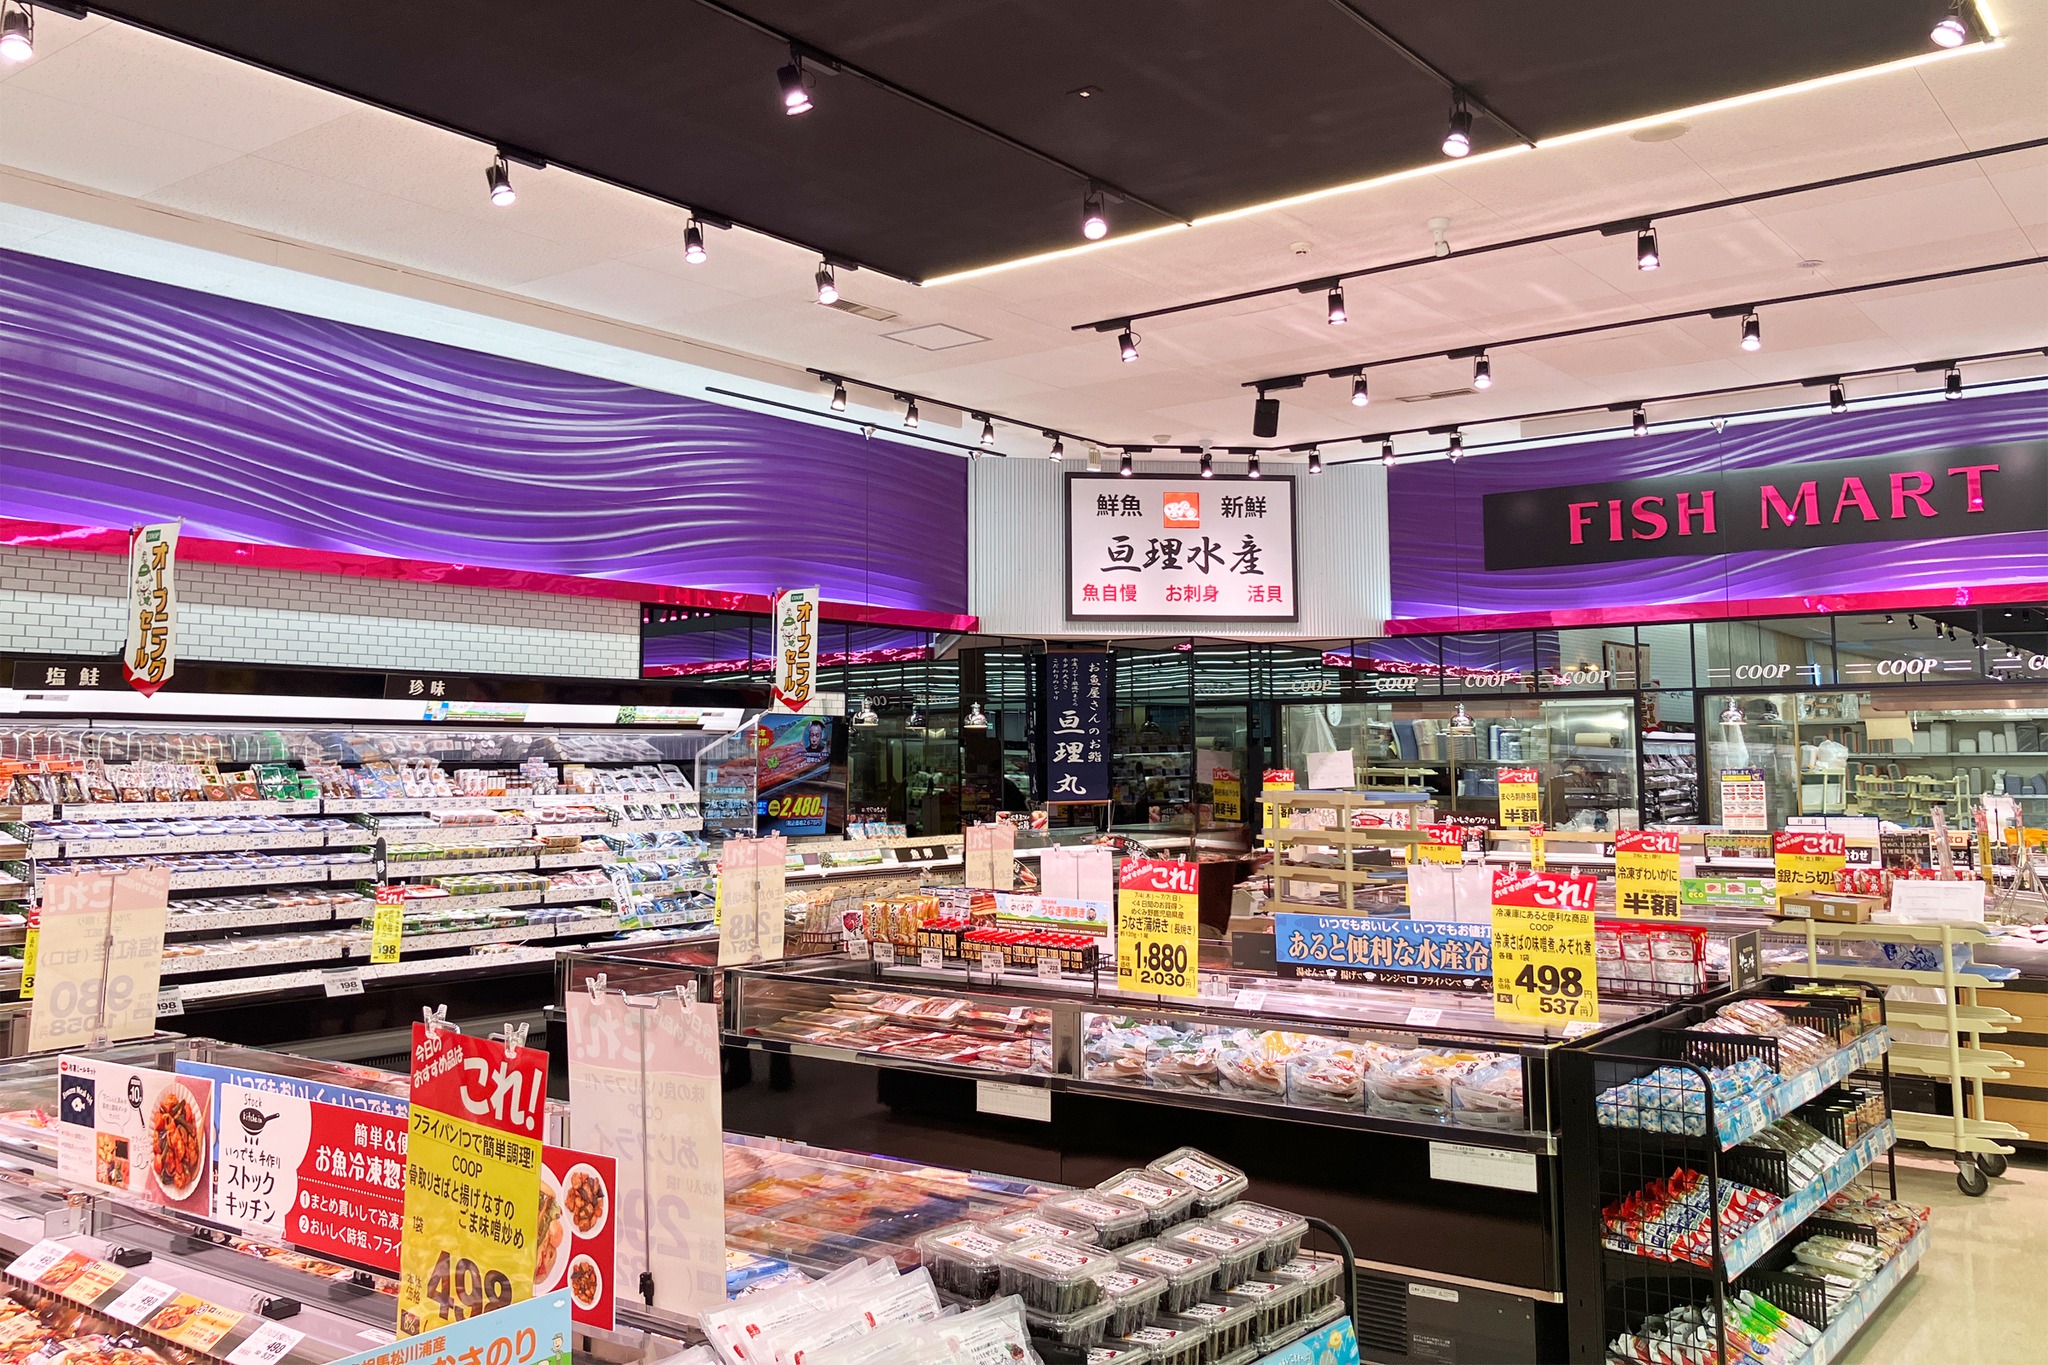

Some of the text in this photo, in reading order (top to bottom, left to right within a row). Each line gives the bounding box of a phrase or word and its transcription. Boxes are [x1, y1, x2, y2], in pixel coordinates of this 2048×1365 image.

[1096, 494, 1267, 518] 鮮魚 新鮮
[1568, 464, 2000, 545] FISH MART
[1100, 533, 1264, 575] 亘理水産
[1082, 584, 1283, 603] 魚自慢 お刺身 活貝
[147, 542, 169, 684] オープニング
[134, 609, 154, 670] セール
[795, 602, 813, 702] オープニング
[46, 667, 100, 686] 塩鮭
[784, 649, 797, 693] セール
[1563, 670, 1611, 684] COOP
[1735, 664, 1791, 680] COOP
[1877, 658, 1937, 675] COOP
[408, 679, 446, 697] 珍味
[1375, 677, 1418, 690] COOP
[1465, 672, 1511, 688] COOP
[1087, 662, 1102, 763] お魚屋さんのお鮨
[1053, 709, 1087, 795] 亘理丸
[1275, 772, 1294, 781] これ!
[1514, 772, 1537, 783] これ!
[1504, 808, 1538, 822] 半額
[1641, 835, 1678, 852] これ!
[1803, 837, 1843, 854] これ!
[1151, 867, 1196, 891] これ!
[1617, 867, 1678, 882] 冷凍ずわいがに
[377, 894, 404, 905] これ!
[1533, 880, 1594, 908] これ!
[1624, 893, 1678, 917] 半額
[1688, 891, 1704, 899] eco
[1121, 916, 1169, 933] うなぎ蒲焼き
[1495, 908, 1589, 923] 冷凍庫にあると便利な商品!
[1319, 917, 1492, 938] いつでもおいしく・いつでもお値打
[1530, 923, 1554, 932] COOP
[1289, 931, 1492, 972] あると便利な水産冷
[1494, 934, 1592, 957] 冷凍さばの味噌煮、みぞれ煮
[1135, 941, 1187, 973] 1,880
[340, 981, 358, 989] 198
[1340, 970, 1363, 981] 揚げで
[1380, 974, 1406, 983] レンジで
[1420, 976, 1461, 988] フライパンで
[1515, 964, 1583, 997] 498
[1540, 997, 1578, 1016] 537
[415, 1037, 442, 1062] 今日の
[413, 1045, 464, 1088] おすすめ品は
[244, 1093, 262, 1108] Stock
[459, 1057, 543, 1131] これ!
[413, 1113, 535, 1169] フライパン1つで簡単調理!
[225, 1148, 281, 1169] いつでも、手作り
[315, 1144, 407, 1191] お魚冷凍惣
[452, 1155, 483, 1179] COOP
[227, 1164, 275, 1196] ストック
[408, 1164, 515, 1221] 骨取りさばと揚げなすの
[226, 1191, 276, 1225] キッチン
[413, 1215, 423, 1234] 1袋
[458, 1209, 524, 1249] ごま味噌炒め
[403, 1314, 416, 1333] 8%
[353, 1335, 447, 1365] 相馬松川浦産
